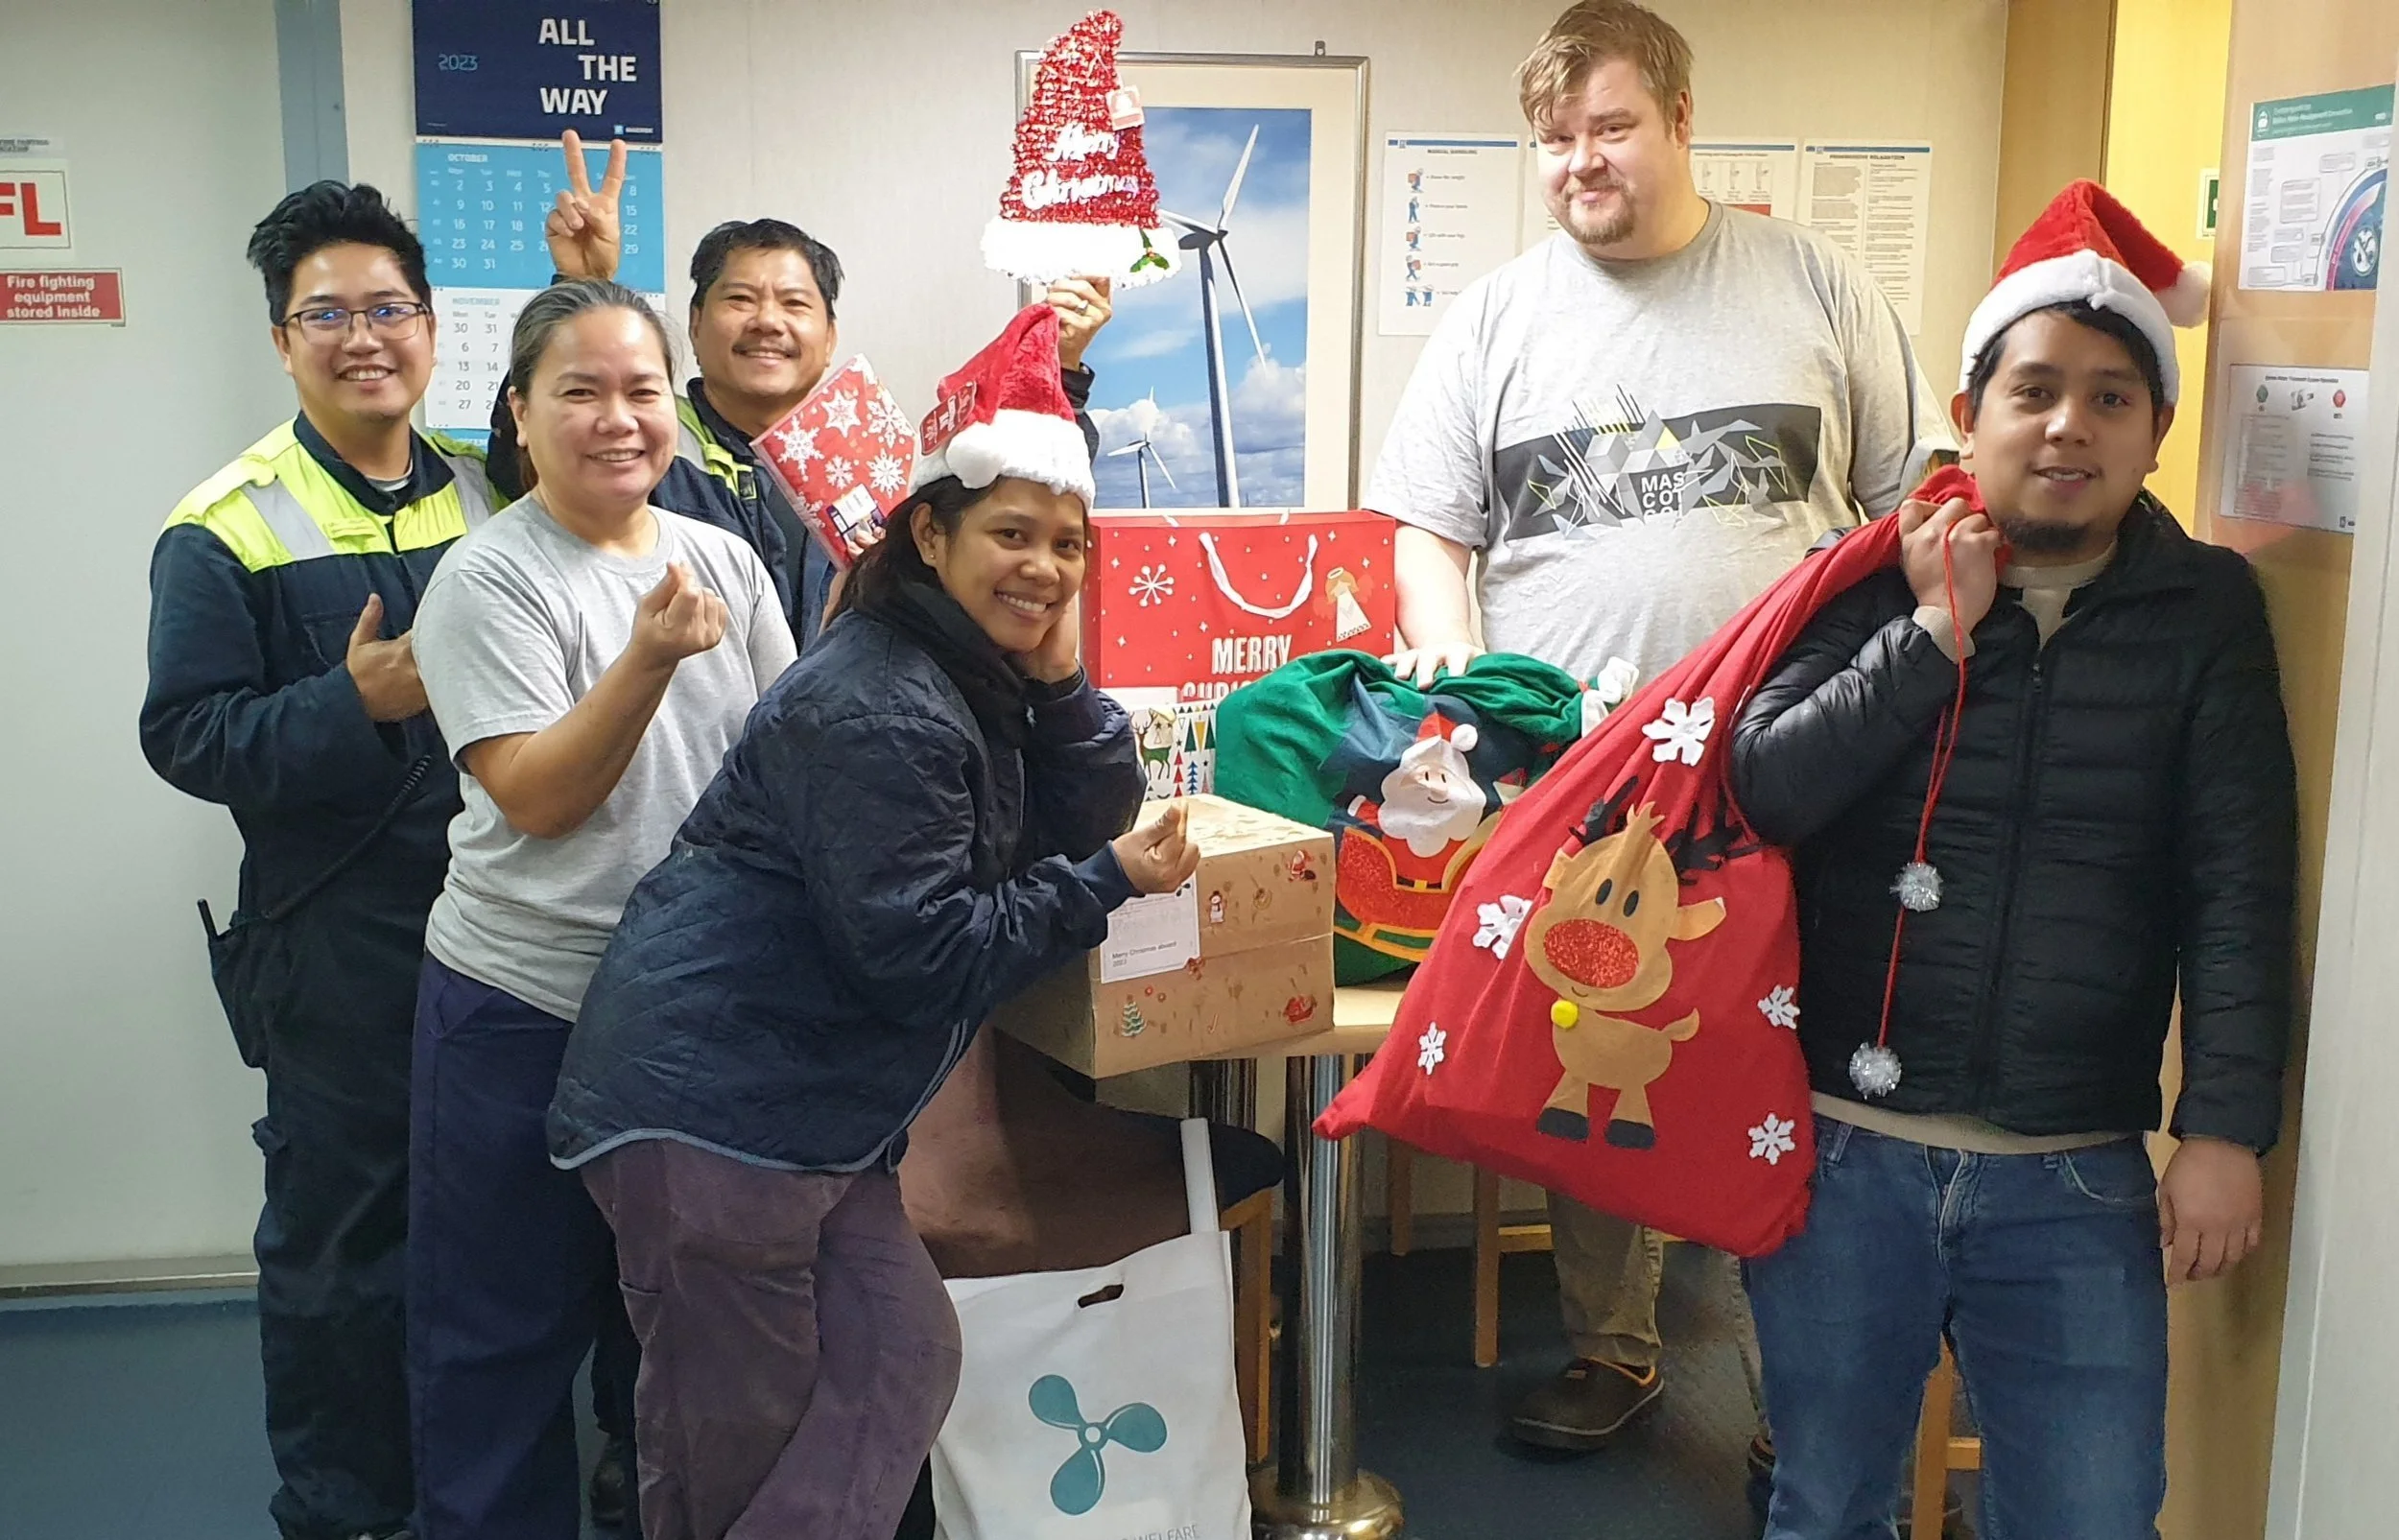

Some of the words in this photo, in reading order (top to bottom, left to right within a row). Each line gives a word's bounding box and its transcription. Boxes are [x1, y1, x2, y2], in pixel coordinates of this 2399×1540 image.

[538, 18, 595, 46] ALL
[438, 53, 479, 72] 2023
[578, 55, 637, 83] THE
[539, 87, 608, 115] WAY
[447, 154, 488, 163] OCTOBER
[456, 179, 464, 192] 2
[486, 180, 494, 192] 3
[513, 181, 523, 193] 4
[543, 182, 551, 194] 5
[629, 185, 637, 197] 8
[457, 200, 465, 211] 9
[482, 200, 495, 212] 10
[512, 201, 523, 212] 11
[539, 201, 554, 213] 12
[626, 204, 637, 217] 15
[453, 219, 466, 231] 16
[483, 220, 496, 231] 17
[511, 220, 524, 232] 18
[624, 224, 638, 236] 22
[452, 238, 467, 250] 23
[481, 239, 496, 250] 24
[510, 240, 525, 251] 25
[625, 243, 639, 255] 29
[451, 257, 467, 270] 30
[483, 257, 496, 270] 31
[7, 274, 36, 288] Fire
[39, 274, 95, 291] fighting
[14, 290, 91, 306] equipment
[453, 297, 500, 306] NOVEMBER
[7, 305, 54, 319] stored
[57, 305, 101, 318] inside
[454, 322, 468, 334] 30
[485, 323, 497, 334] 31
[462, 343, 469, 353] 6
[491, 344, 499, 353] 7
[459, 361, 470, 372] 13
[487, 362, 499, 372] 14
[455, 380, 471, 391] 20
[487, 381, 499, 391] 21
[458, 399, 471, 411] 27
[1641, 471, 1685, 493] MAS
[1642, 489, 1682, 509] COT
[1211, 634, 1293, 675] MERRY
